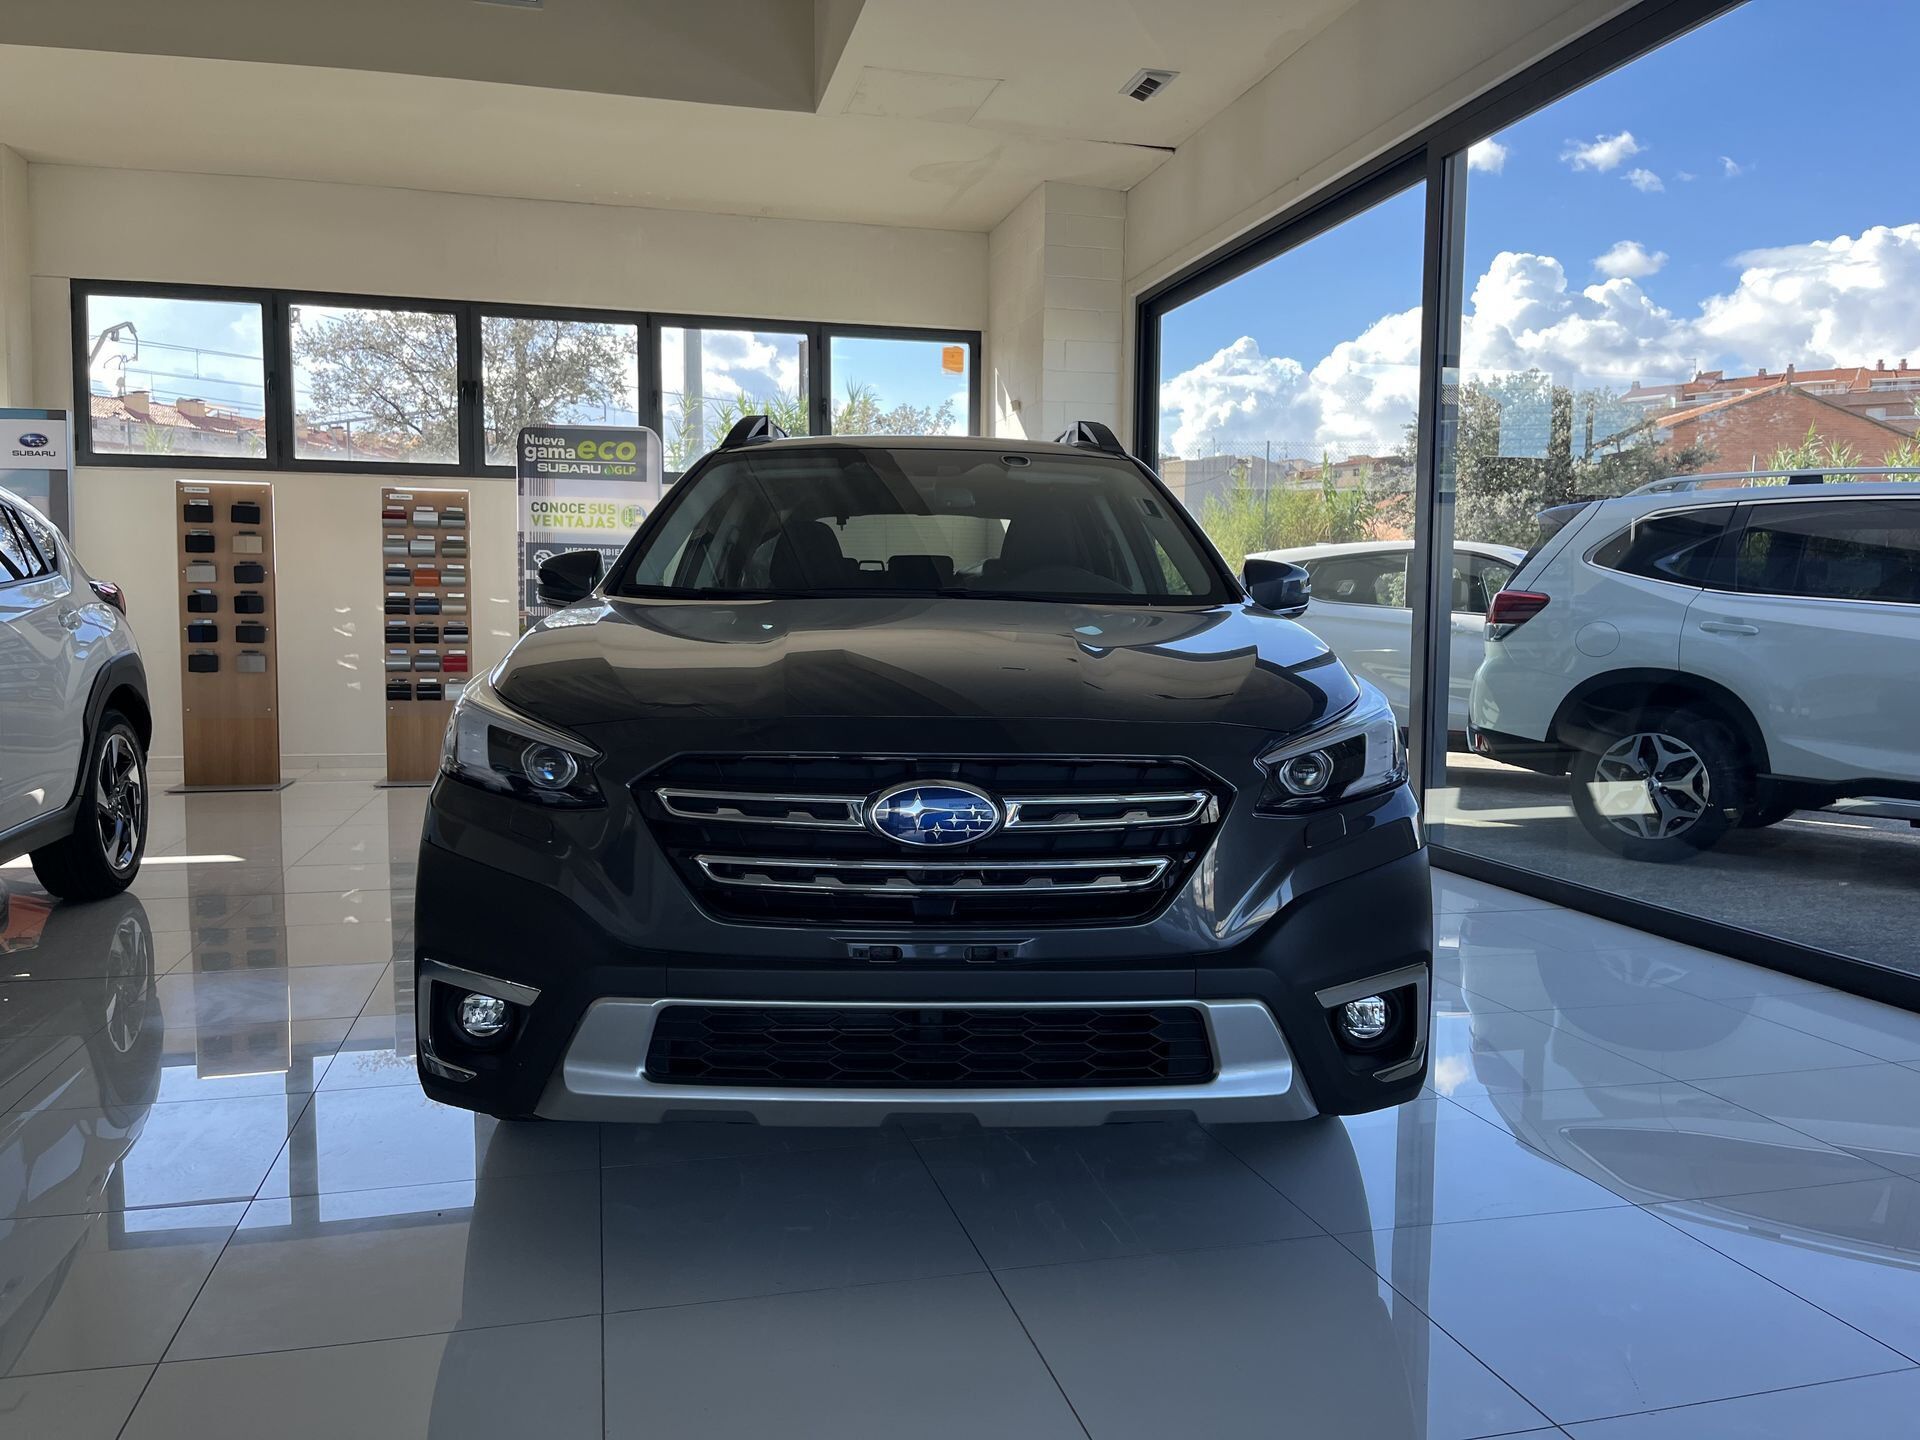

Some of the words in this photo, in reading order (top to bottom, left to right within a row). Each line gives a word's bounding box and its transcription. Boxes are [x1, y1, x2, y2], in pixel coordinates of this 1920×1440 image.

[524, 434, 565, 446] Nueva
[524, 446, 576, 462] gama
[577, 440, 637, 461] eco
[537, 463, 601, 474] SUBARU
[615, 464, 637, 475] GLP
[531, 502, 586, 514] CONOCE
[588, 503, 616, 515] SUS
[531, 514, 616, 529] VENTAJAS
